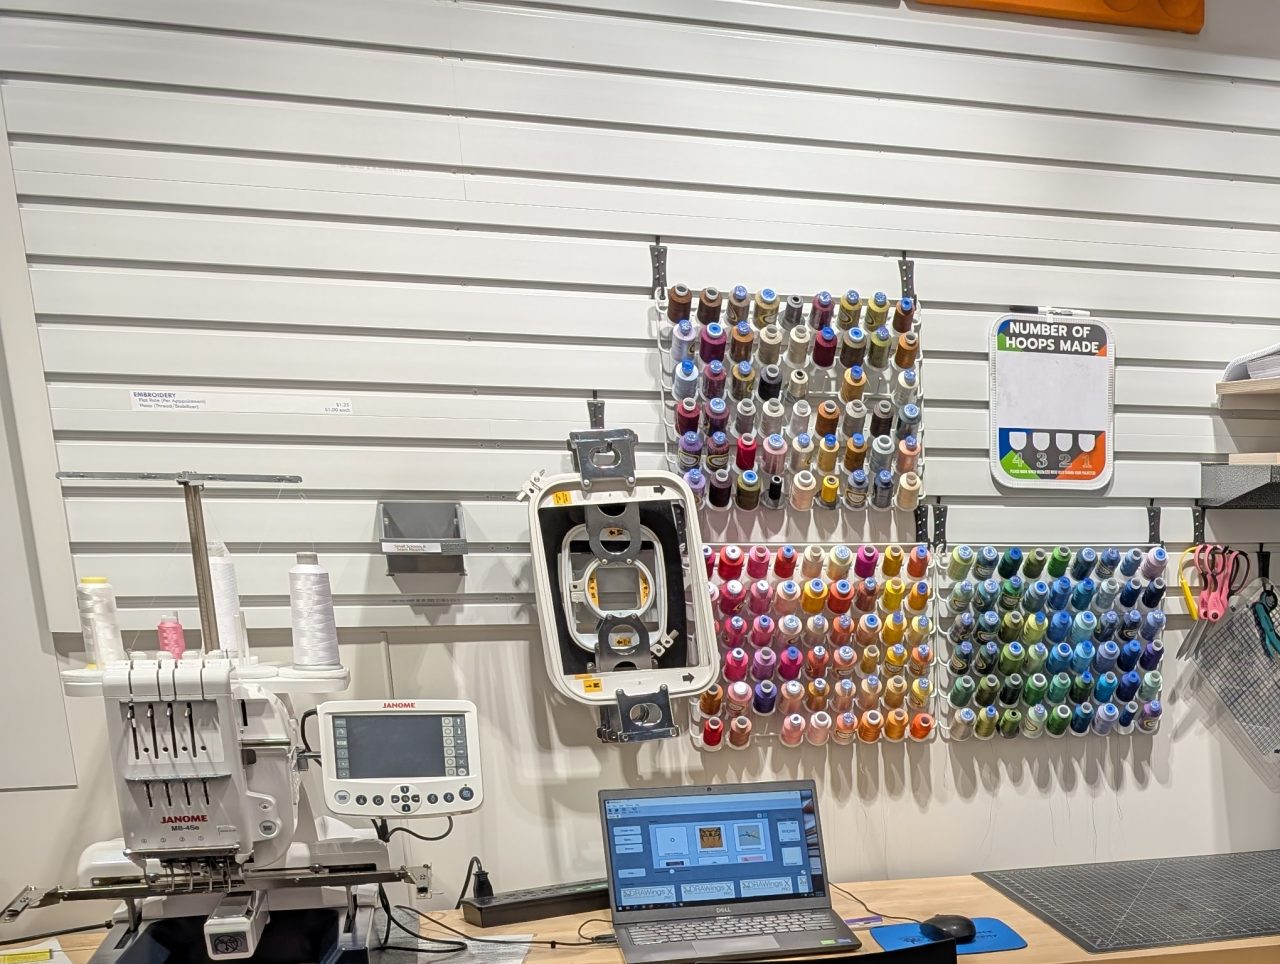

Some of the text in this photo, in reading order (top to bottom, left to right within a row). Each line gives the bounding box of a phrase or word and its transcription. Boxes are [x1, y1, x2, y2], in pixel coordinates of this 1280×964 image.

[1010, 322, 1091, 338] NUMBER OF
[1006, 336, 1099, 353] HOOPS MADE
[1012, 452, 1092, 468] 4 3 2 1
[160, 815, 208, 823] JANOME
